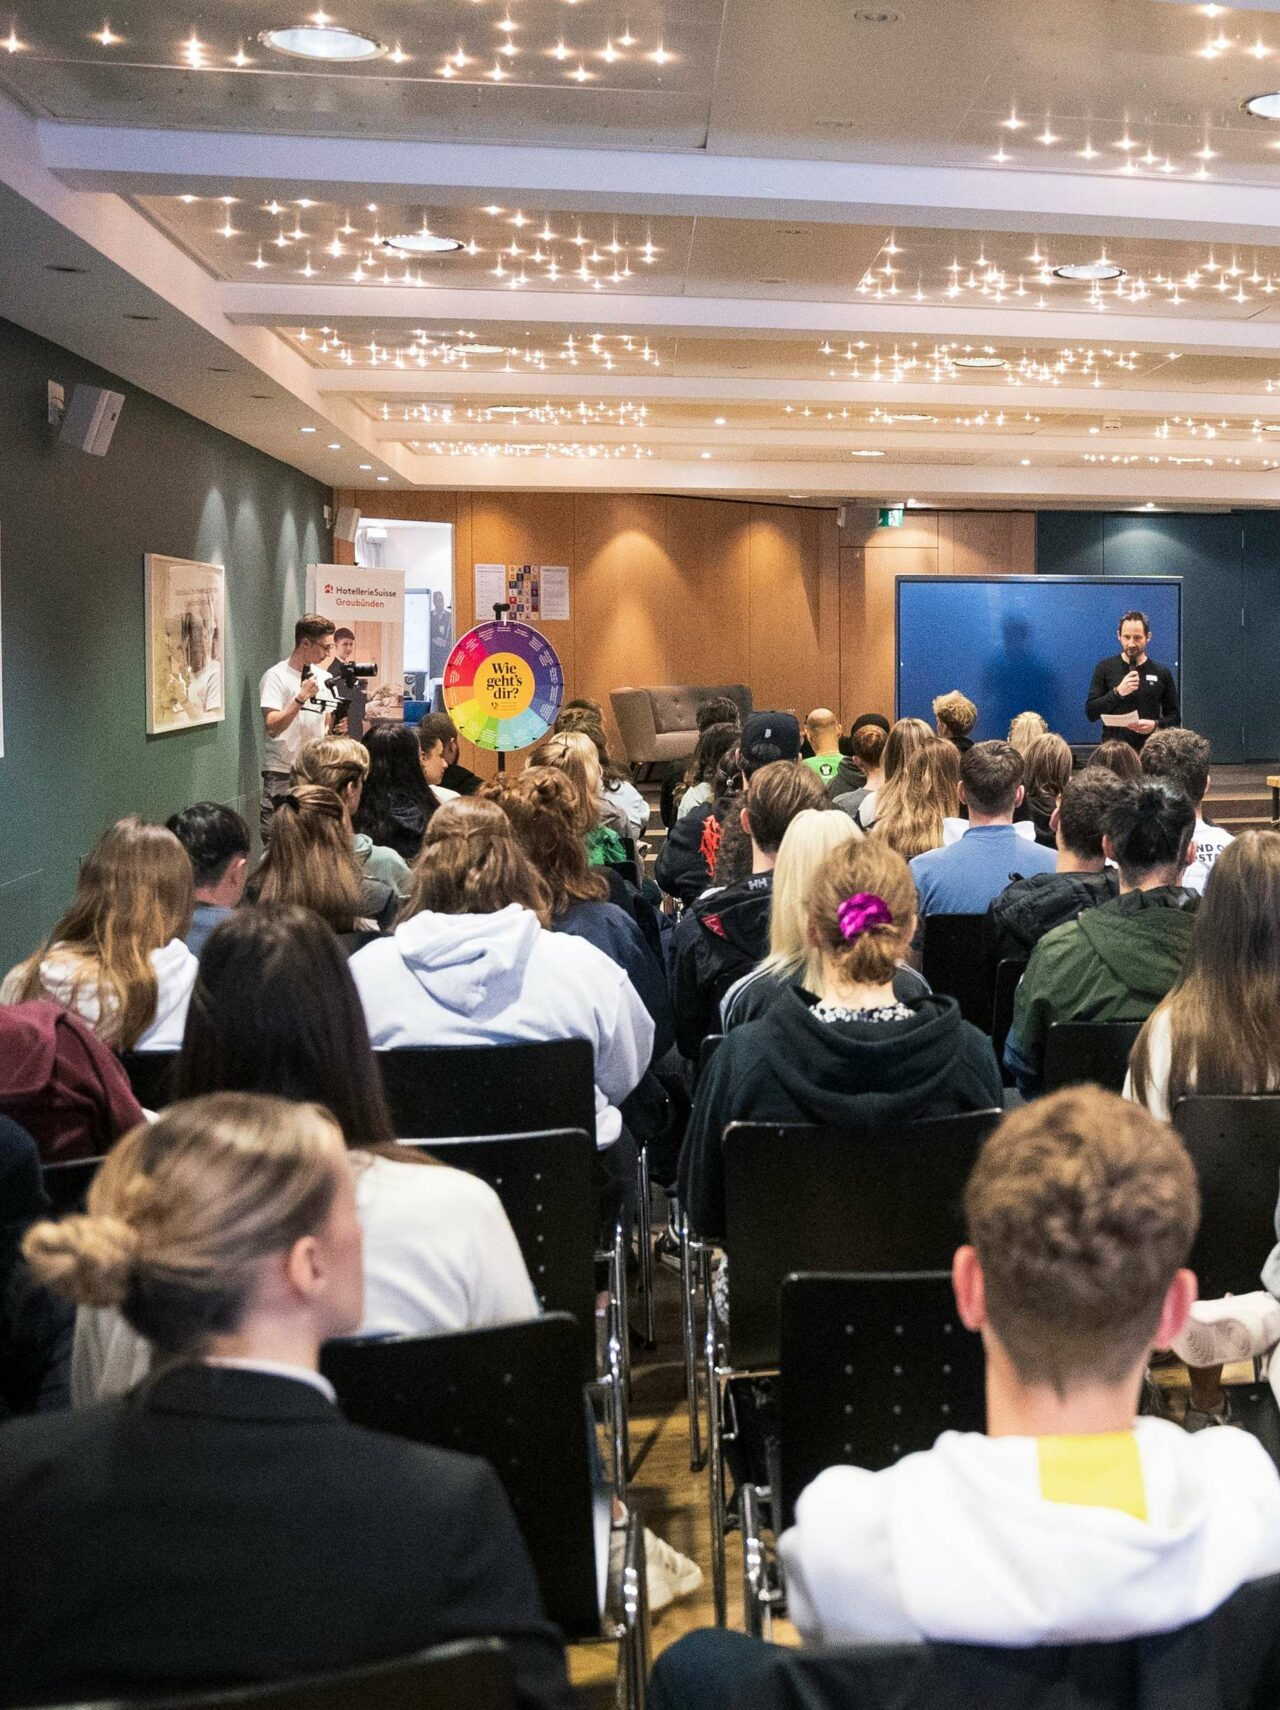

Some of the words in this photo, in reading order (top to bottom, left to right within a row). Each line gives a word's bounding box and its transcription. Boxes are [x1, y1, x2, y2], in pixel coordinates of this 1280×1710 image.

[336, 586, 397, 598] HotellerieSuisse
[335, 598, 385, 608] Graubünden
[491, 662, 517, 674] Wie
[486, 674, 523, 690] geht's
[493, 687, 520, 699] dir?
